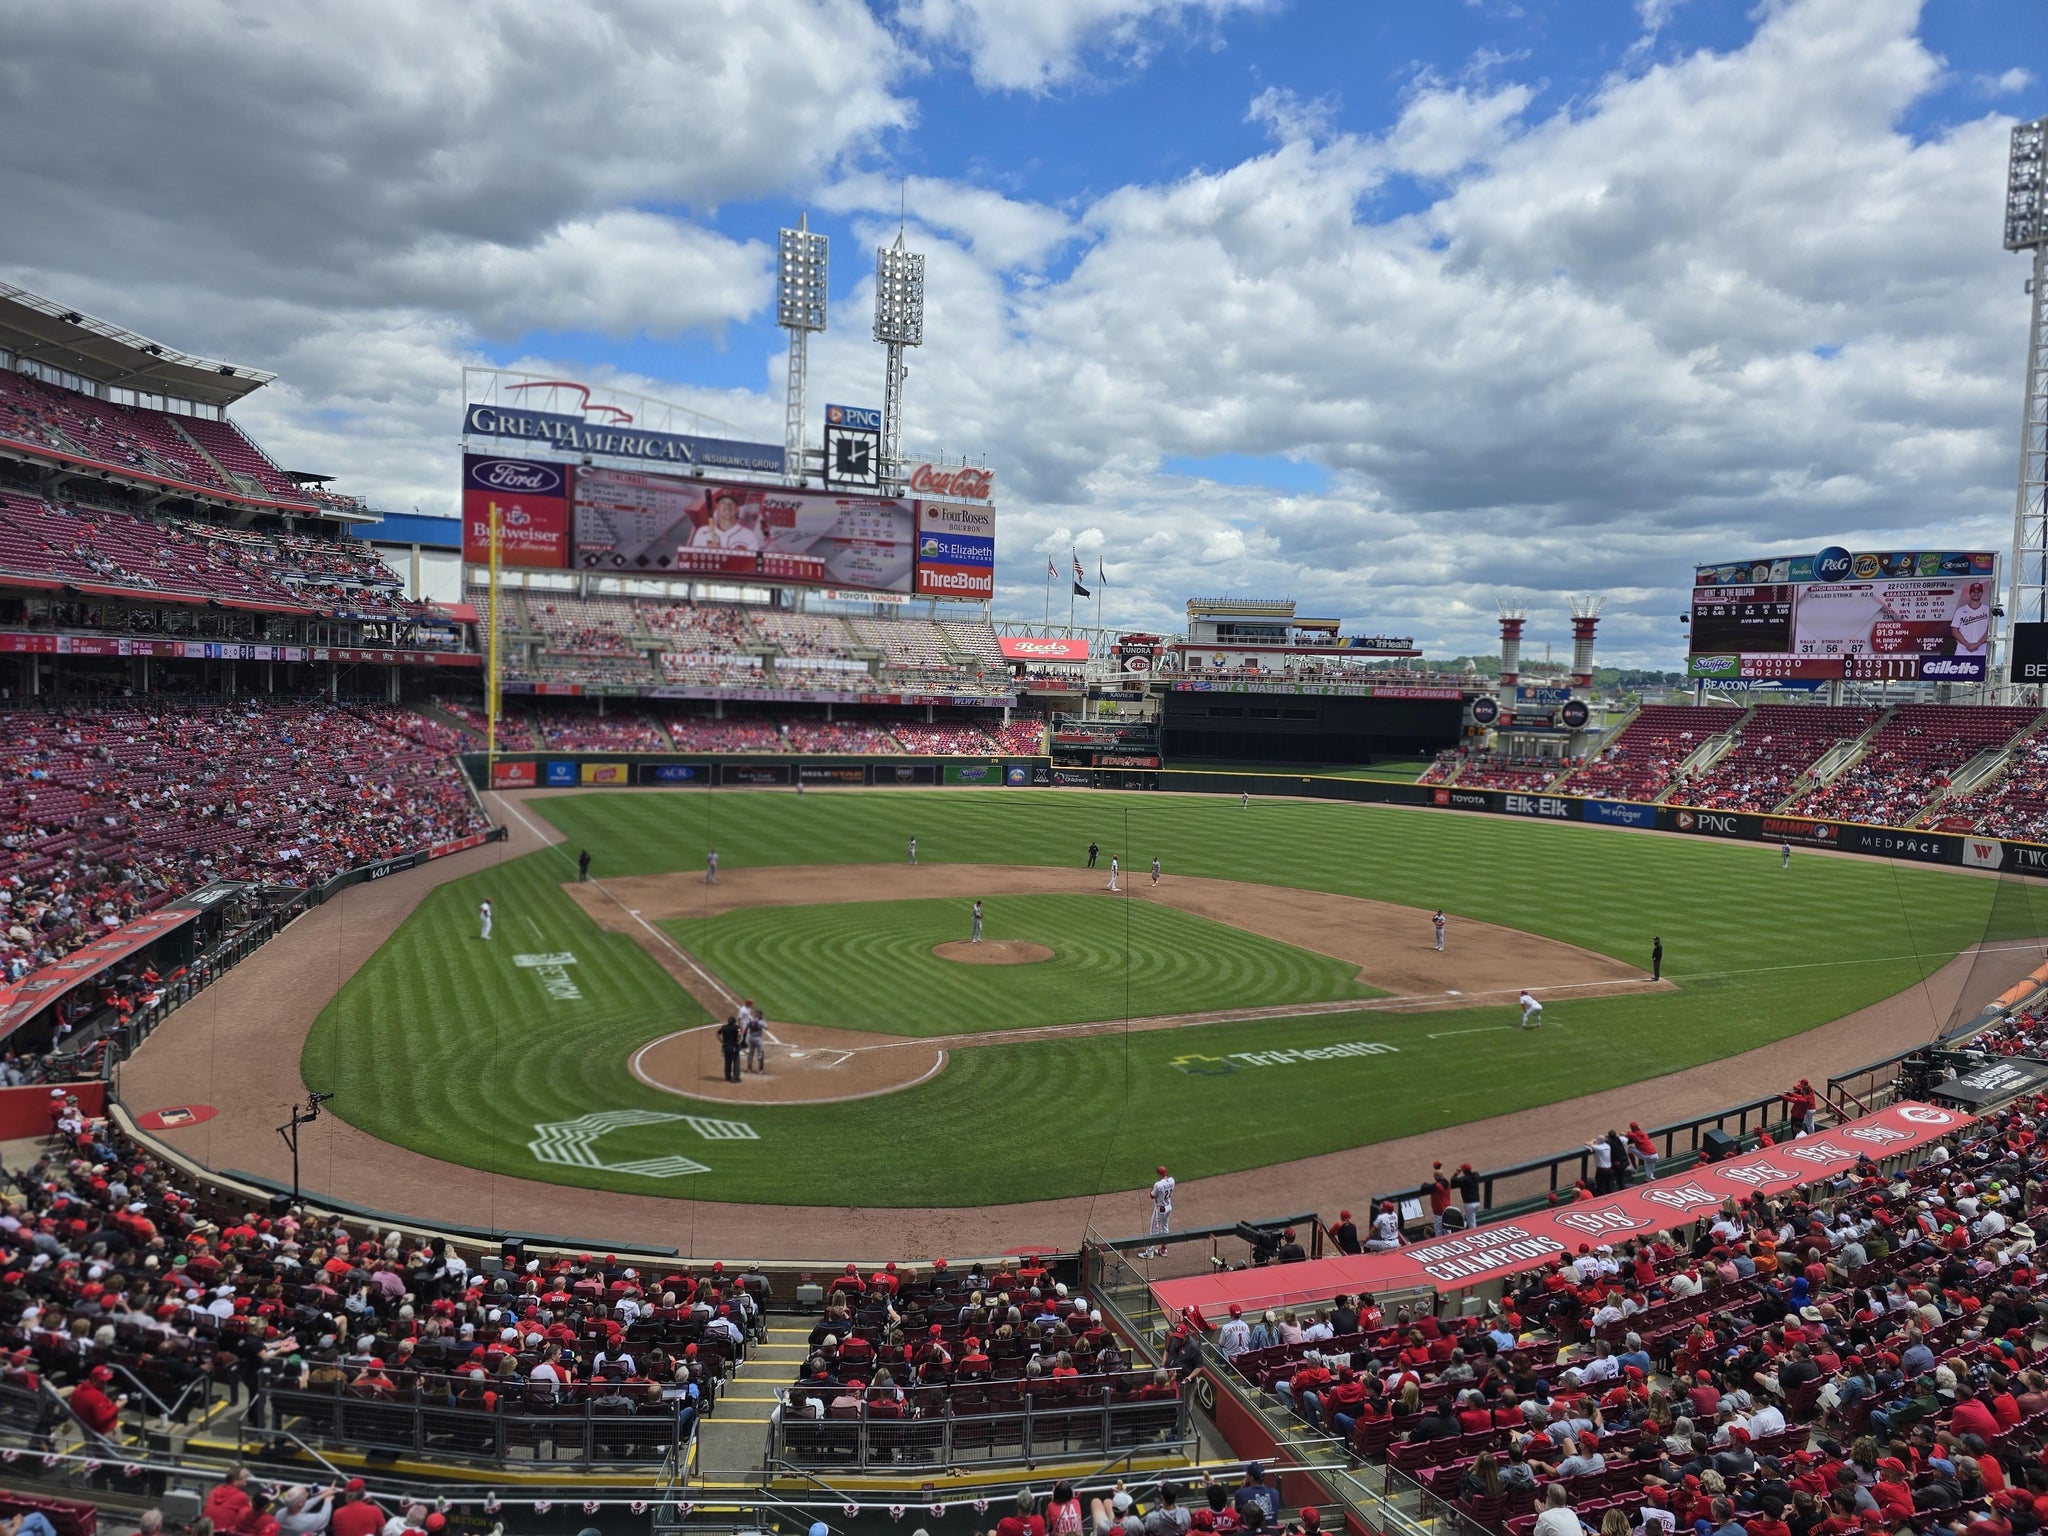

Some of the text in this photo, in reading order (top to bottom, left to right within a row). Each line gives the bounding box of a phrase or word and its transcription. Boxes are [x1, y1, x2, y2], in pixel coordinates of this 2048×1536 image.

[845, 409, 880, 426] PNC
[472, 408, 695, 460] GREAT AMERICAN
[702, 453, 780, 470] INSURANCE GROUP
[489, 463, 543, 488] Ford
[942, 508, 987, 524] Four Roses
[949, 523, 981, 533] BOURBON
[951, 544, 992, 557] Elizabeth
[1822, 557, 1850, 571] P&G
[1855, 561, 1878, 574] Tide
[1792, 568, 1812, 576] Pampers
[920, 569, 991, 591] ThreeBond
[838, 592, 903, 603] TOYOTA TUNDRA
[1735, 588, 1755, 596] BULLPEN
[1013, 642, 1069, 653] Reds
[1375, 639, 1413, 650] TriHealth
[1802, 645, 1863, 653] 31 56 87
[1694, 657, 1735, 673] Swiffer
[1923, 661, 1980, 675] Gillette
[1210, 683, 1232, 692] BUY
[1236, 683, 1244, 692] 4
[1249, 684, 1299, 695] WASHES,
[1302, 685, 1323, 694] GET
[1338, 687, 1366, 696] FREE
[1703, 678, 1749, 690] BEACON
[1374, 688, 1460, 699] MIKE'S CARWASH
[1536, 690, 1562, 699] PNC
[663, 768, 688, 778] ACR
[958, 767, 987, 779] Swiffer
[1452, 794, 1485, 805] TOYOTA
[1611, 808, 1643, 823] Kroger
[1698, 814, 1737, 833] PNC
[1861, 836, 1939, 854] MEDPACE
[1229, 1041, 1400, 1067] TriHealth
[1793, 1145, 1850, 1162] 1976
[1725, 1165, 1787, 1184] 1975
[1651, 1187, 1716, 1207] 1940
[1565, 1212, 1636, 1231] 1919
[1406, 1225, 1530, 1263] WORLD SERIES
[1425, 1236, 1565, 1281] CHAMPIONS
[941, 1493, 978, 1502] SECTION
[450, 1514, 487, 1527] SECTION
